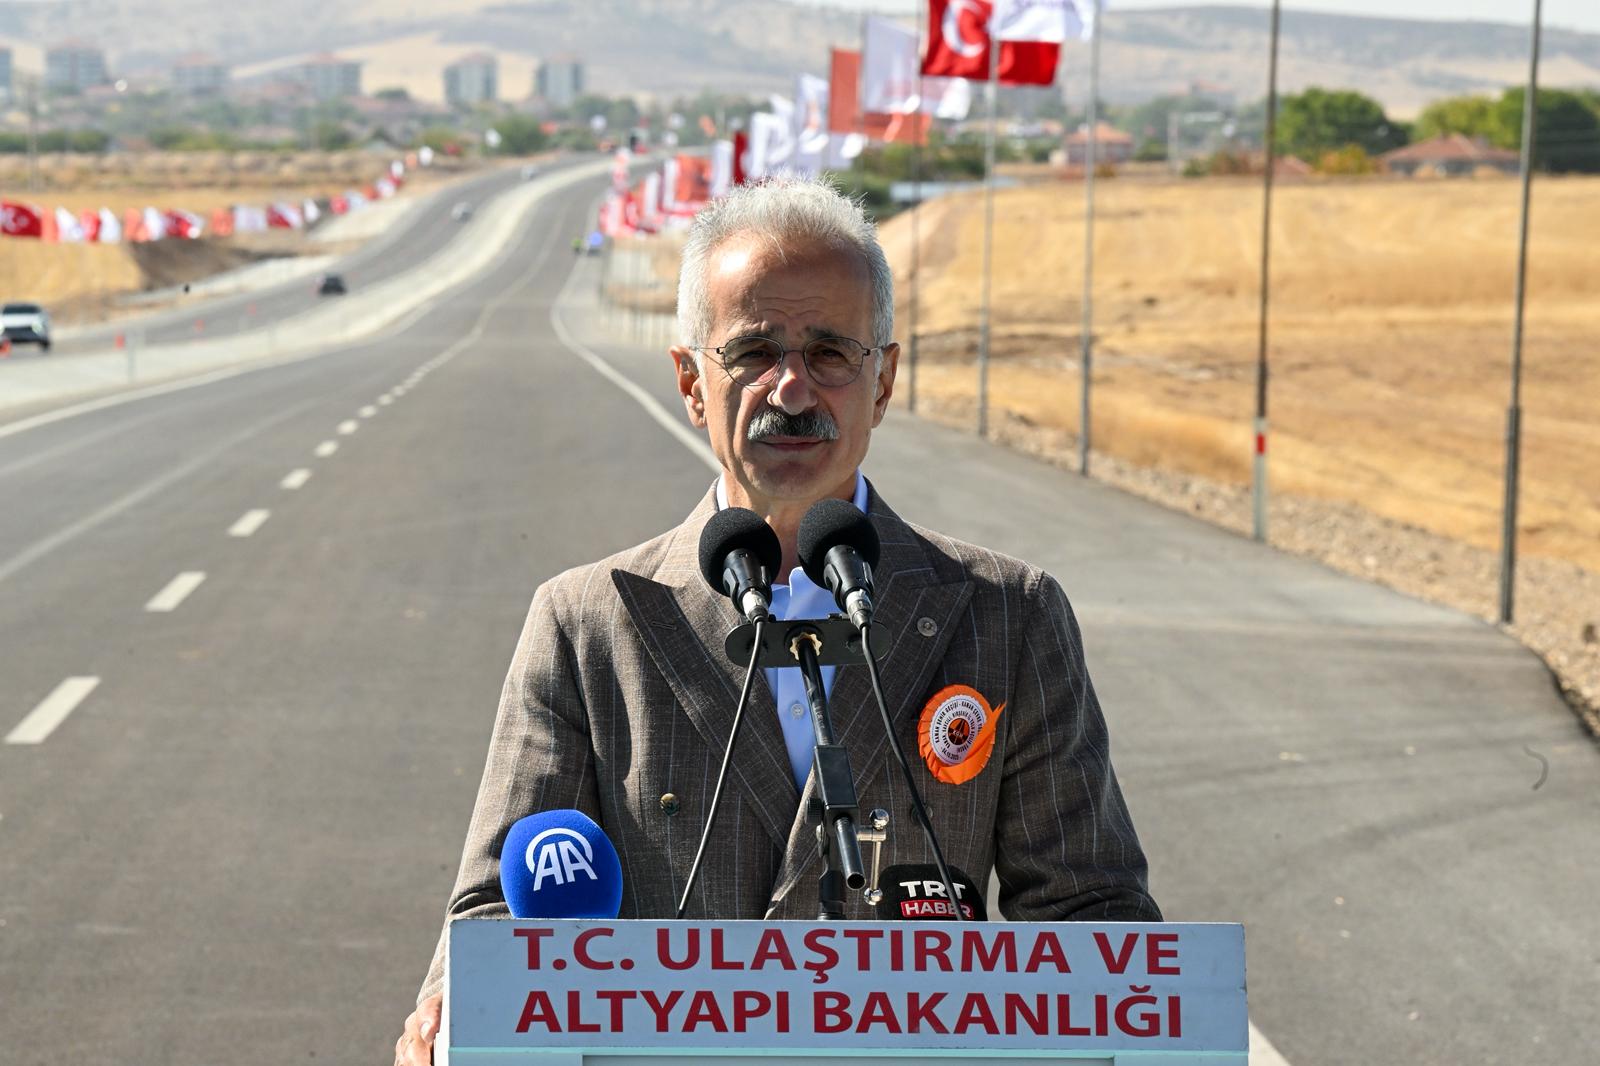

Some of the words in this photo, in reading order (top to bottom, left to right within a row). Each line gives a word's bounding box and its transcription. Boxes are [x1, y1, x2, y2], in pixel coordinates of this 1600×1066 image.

[533, 840, 598, 892] AA
[899, 880, 966, 899] TRT
[904, 902, 972, 917] HABER
[513, 927, 635, 971] T.C.
[656, 927, 1072, 984] ULAŞTIRMA
[1092, 932, 1181, 976] VE
[515, 990, 790, 1033] ALTYAPI
[812, 984, 1182, 1038] BAKANLIĞI
